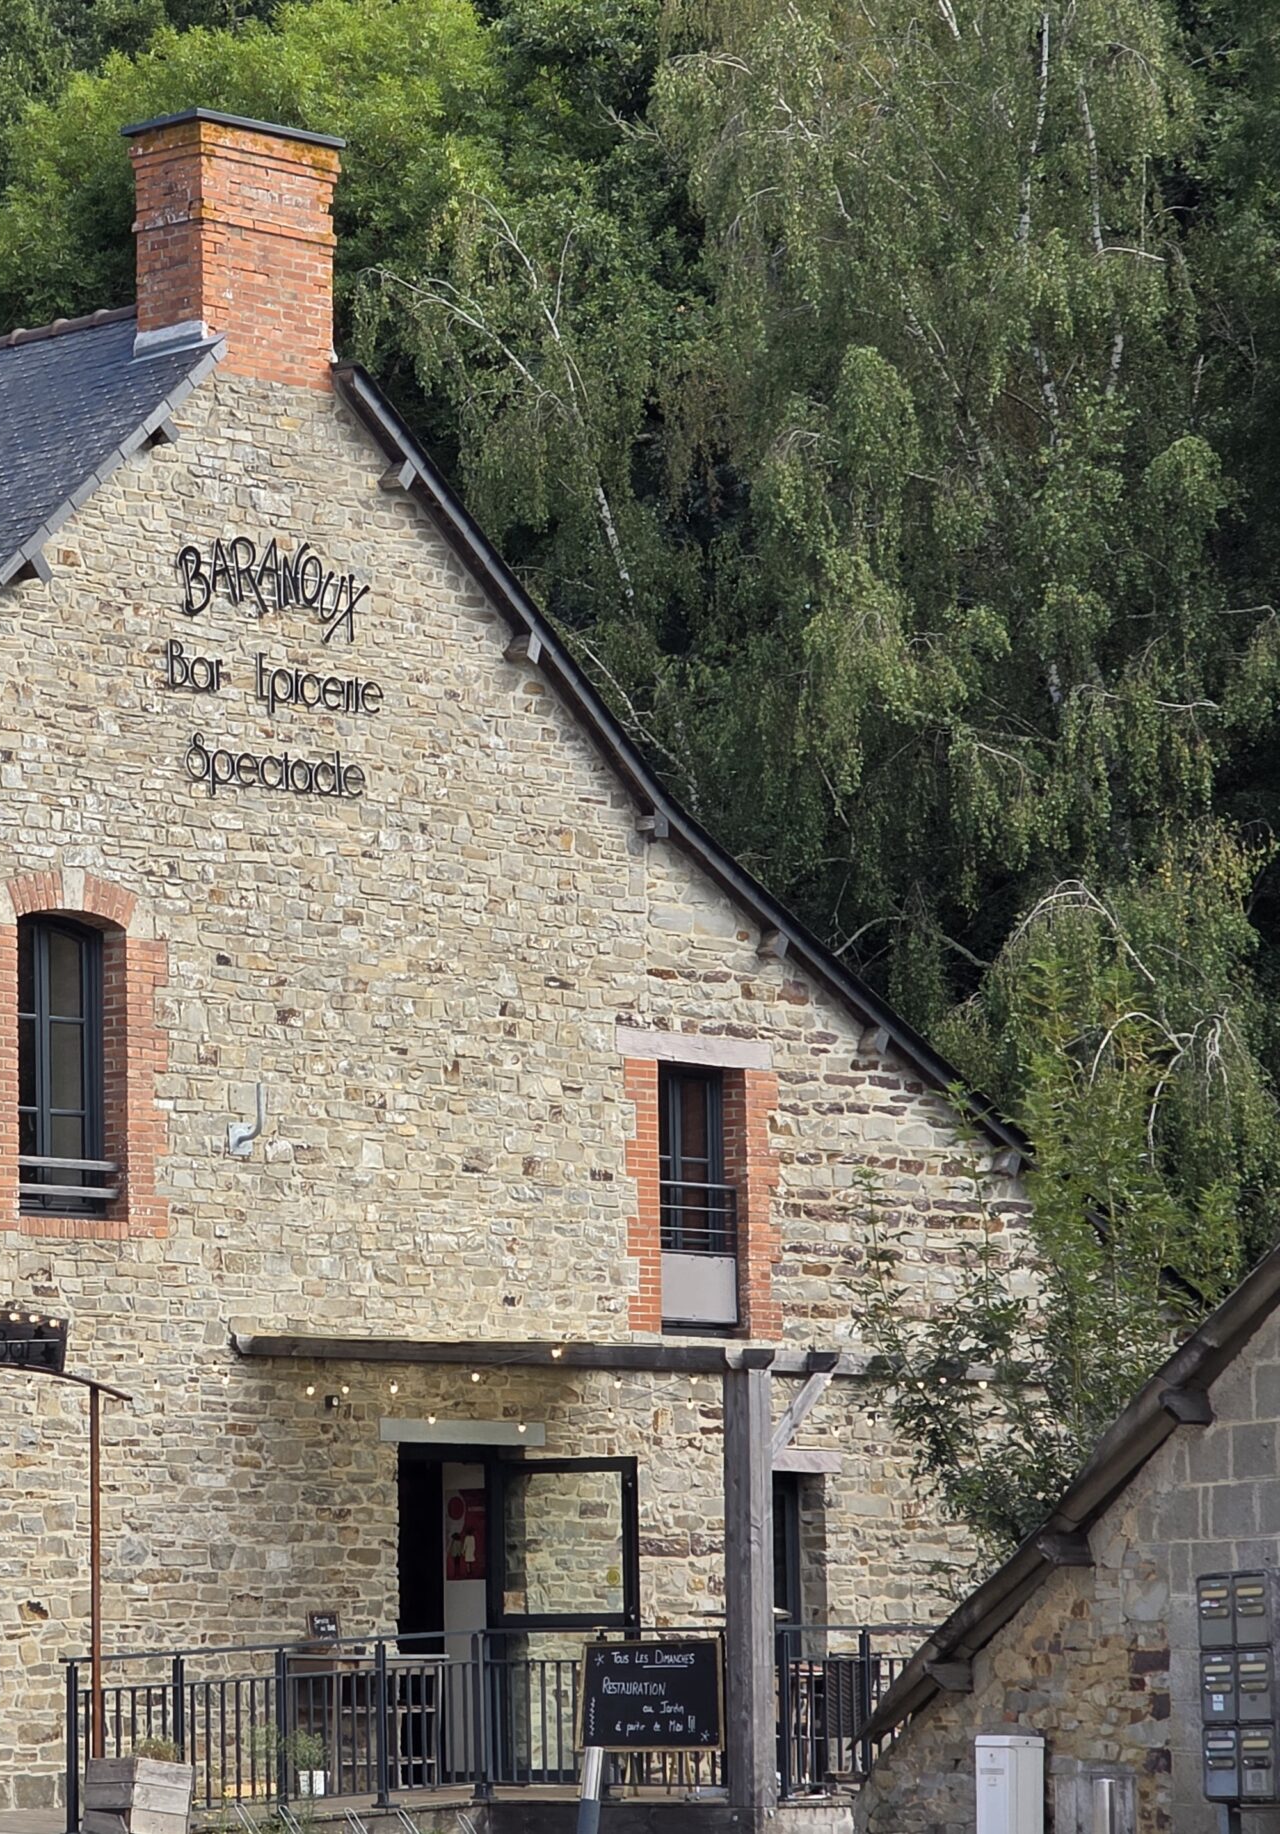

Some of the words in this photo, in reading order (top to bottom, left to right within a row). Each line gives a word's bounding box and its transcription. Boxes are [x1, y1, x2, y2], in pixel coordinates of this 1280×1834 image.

[177, 536, 370, 643] BARANOUX
[167, 639, 223, 691] Bar
[184, 731, 366, 799] Spectacle
